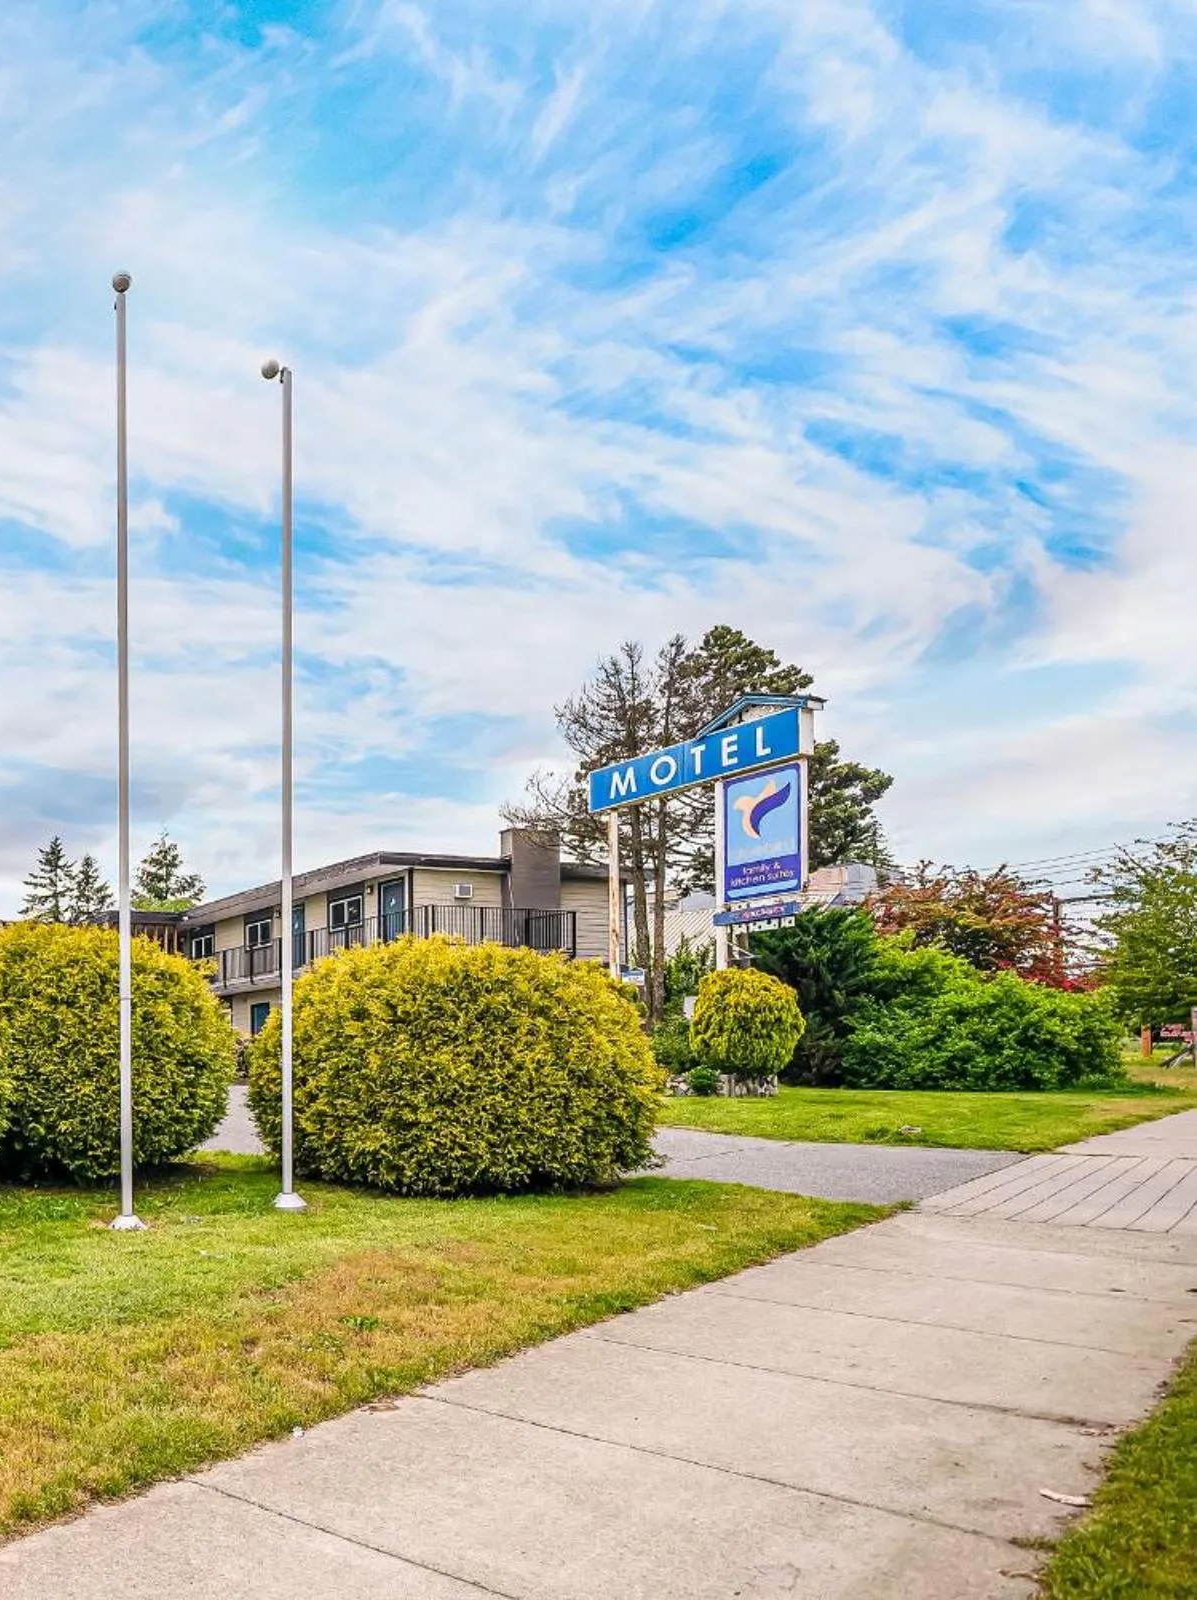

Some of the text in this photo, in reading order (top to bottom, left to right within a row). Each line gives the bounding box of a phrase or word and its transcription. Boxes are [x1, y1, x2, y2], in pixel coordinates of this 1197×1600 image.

[609, 726, 771, 800] MOTEL
[742, 863, 770, 875] family
[730, 875, 765, 887] kitchen
